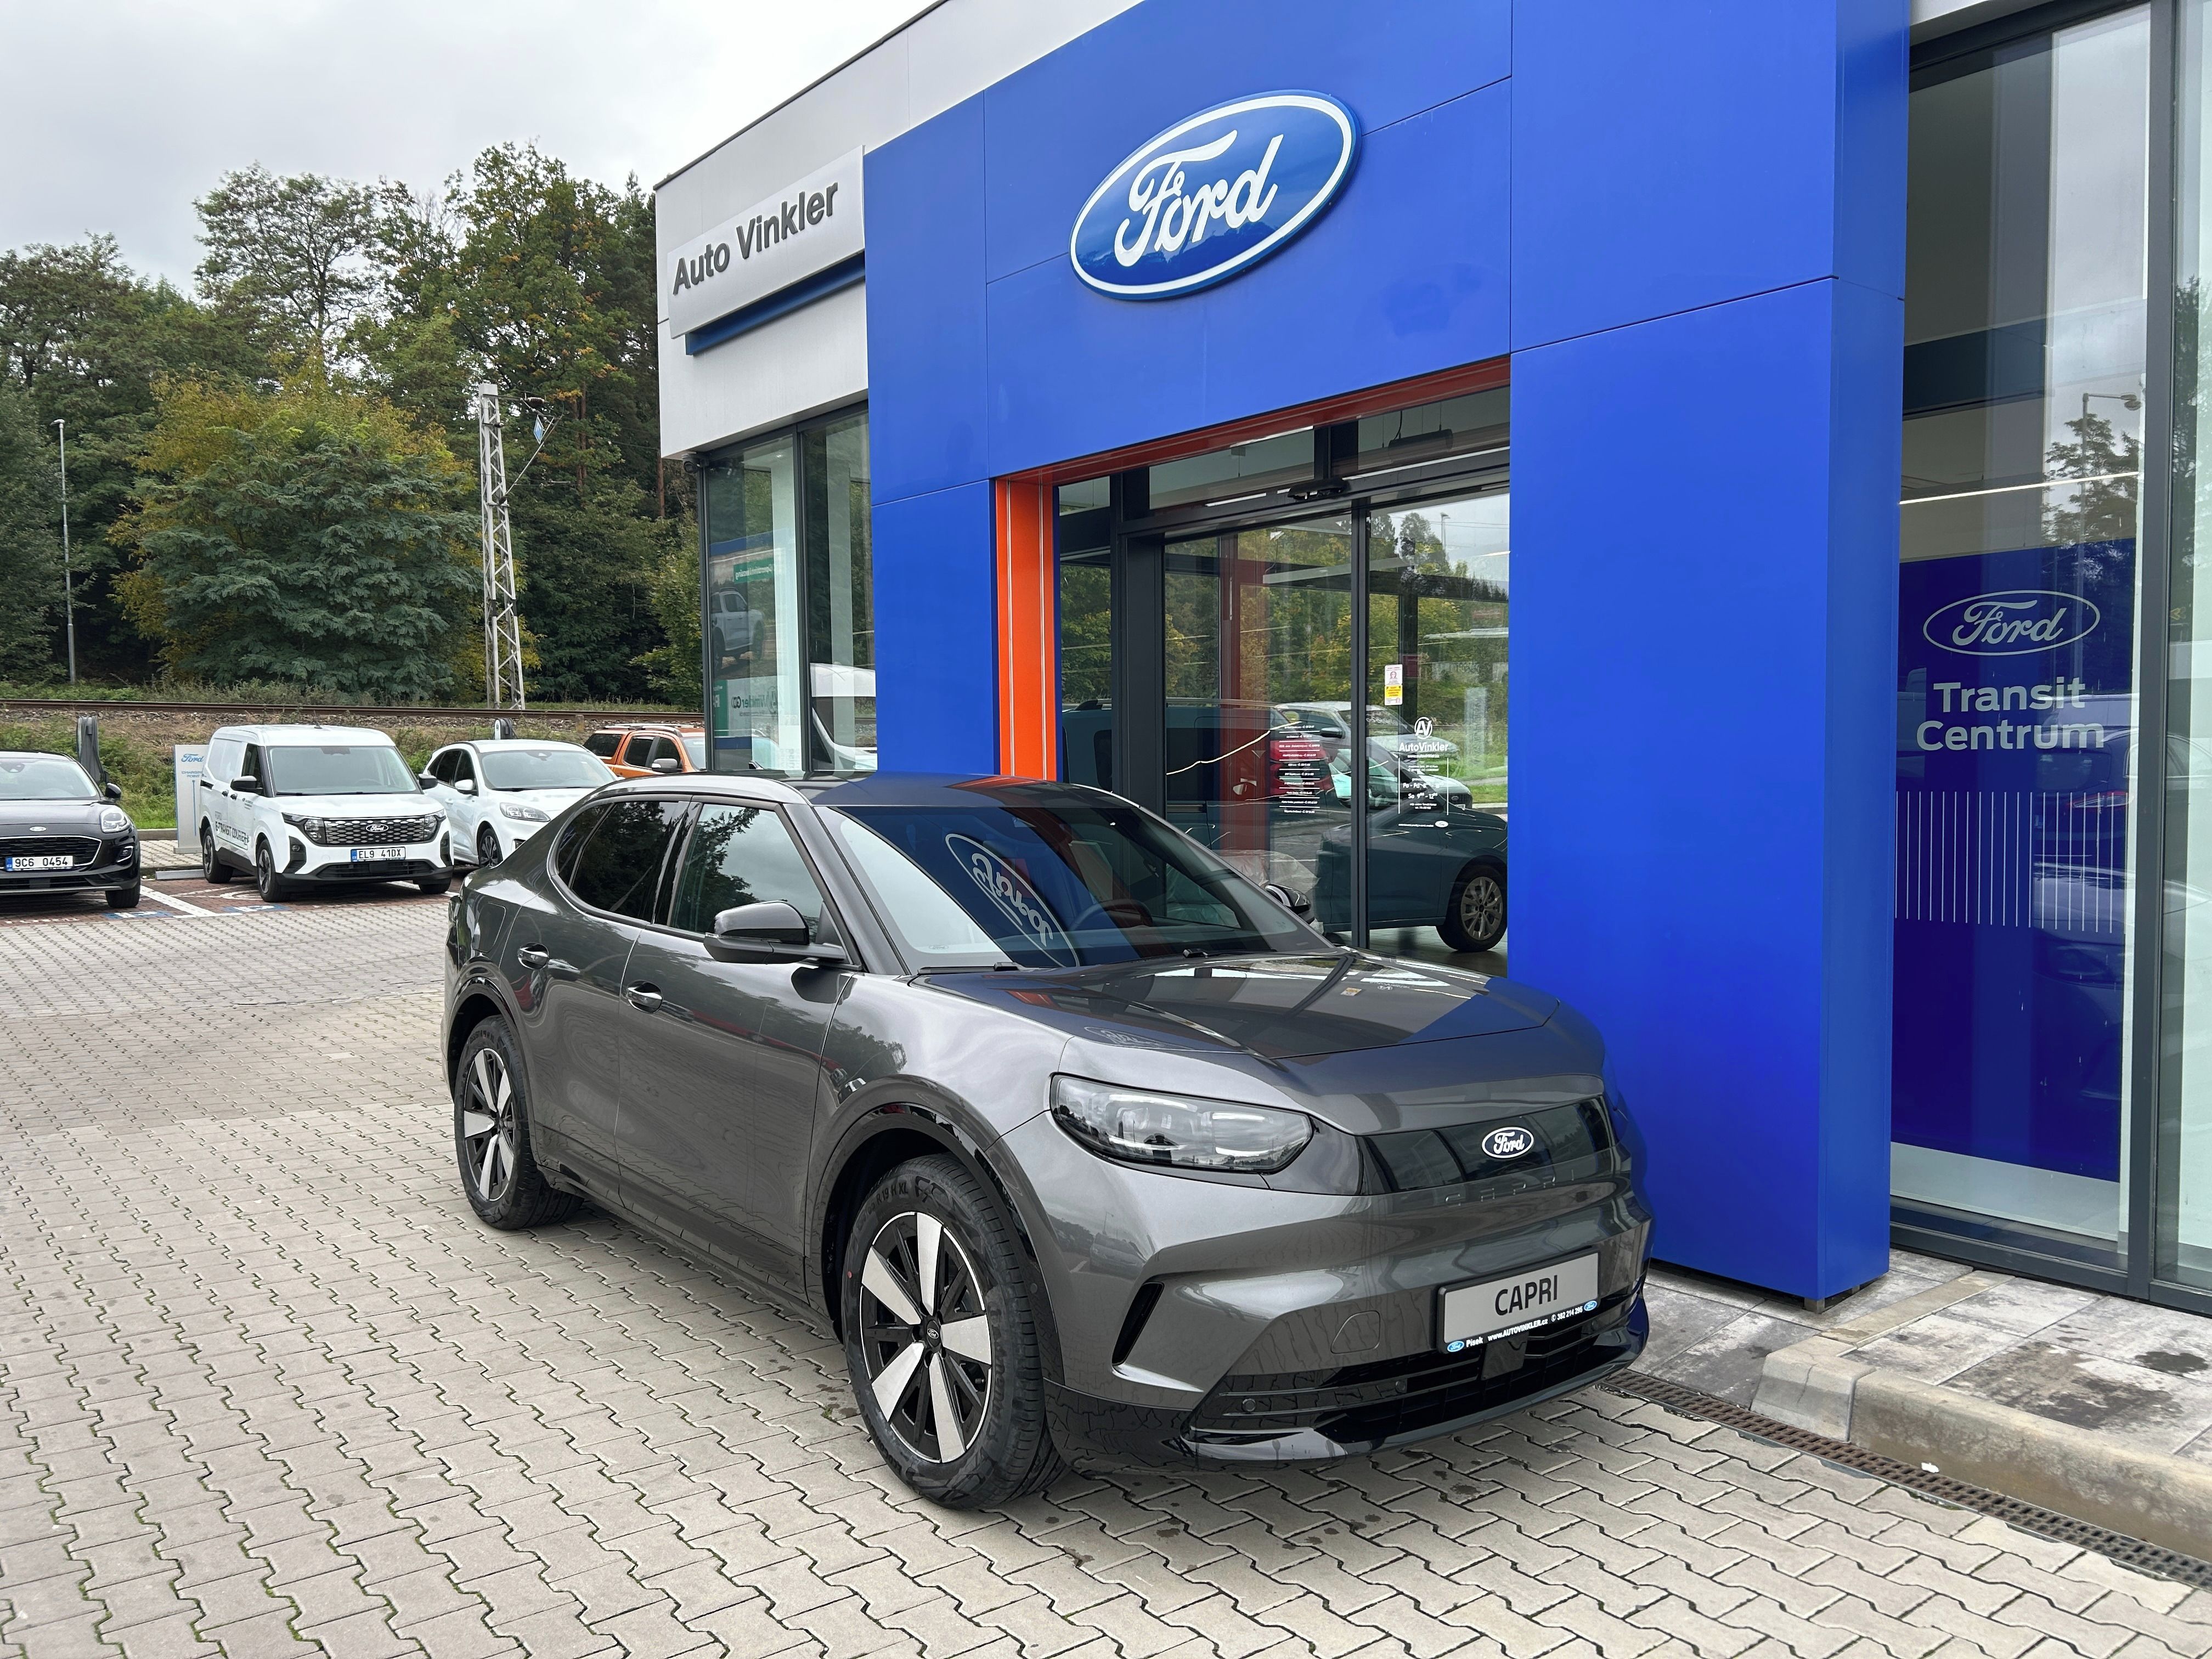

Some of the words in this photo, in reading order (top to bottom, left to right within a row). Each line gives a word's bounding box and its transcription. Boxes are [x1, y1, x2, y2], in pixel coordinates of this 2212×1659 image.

[1114, 129, 1284, 267] Ford
[673, 242, 730, 296] Auto
[736, 182, 838, 259] Vinkler
[1952, 600, 2067, 646] Ford
[1933, 676, 2086, 713] Transit
[1399, 742, 1449, 752] AutoVinkler
[1917, 720, 2104, 751] Centrum
[181, 753, 204, 762] Ford
[15, 858, 34, 867] 9C6
[43, 857, 68, 866] 0454
[359, 850, 375, 859] EL9
[381, 849, 401, 857] 41DX
[1493, 1131, 1525, 1154] Ford
[881, 1186, 890, 1200] 19
[1494, 1274, 1558, 1316] CAPRI
[1487, 1319, 1549, 1341] www.AUTOVINKLER.cz
